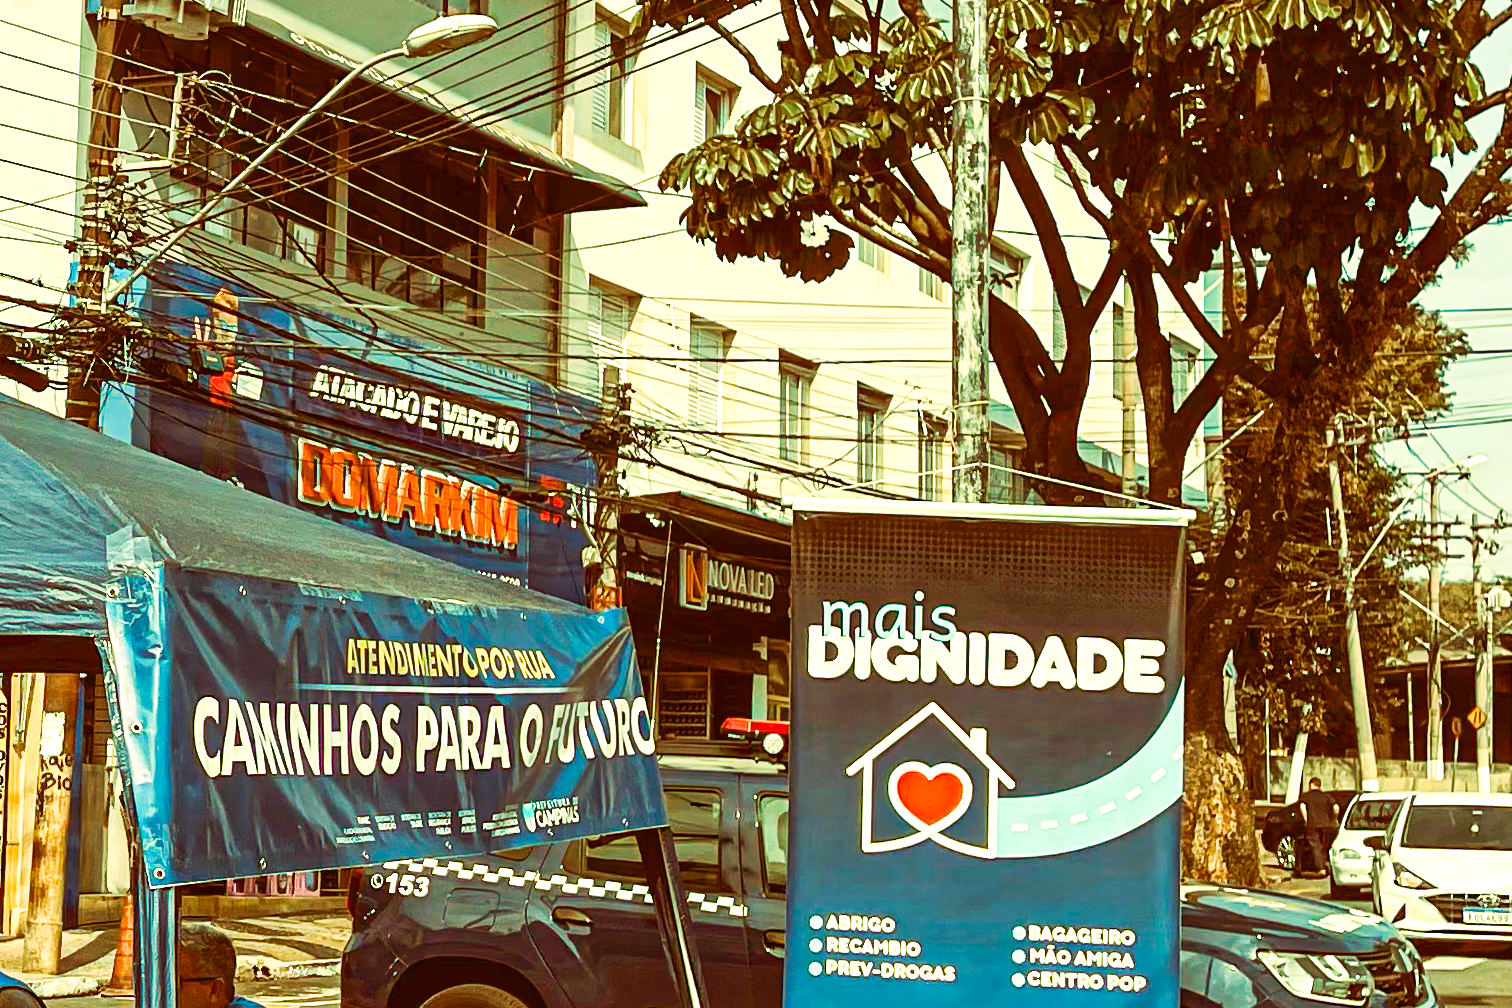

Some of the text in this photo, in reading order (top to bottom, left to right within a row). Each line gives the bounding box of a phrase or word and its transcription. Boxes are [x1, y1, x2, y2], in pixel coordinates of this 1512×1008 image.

[420, 396, 441, 430] E
[442, 400, 521, 453] VAREJO
[296, 436, 519, 550] DOMARKIM
[708, 559, 775, 600] NOVA LED
[822, 590, 957, 642] mais
[347, 638, 556, 679] ATENDIMENTO POP RUA
[807, 624, 1166, 694] DIGNIDADE
[193, 696, 656, 778] CAMINHOS PARA O FUTURO
[535, 805, 580, 828] CAMPINAS
[385, 872, 430, 898] 153
[825, 914, 896, 934] ABRIGO
[1028, 924, 1136, 946] BAGAGEIRO
[825, 936, 922, 958] RECAMBIO
[1029, 944, 1135, 969] MÃO AMIGA
[825, 959, 957, 982] PREV-DROGAS
[1026, 970, 1148, 992] CENTRO POP
